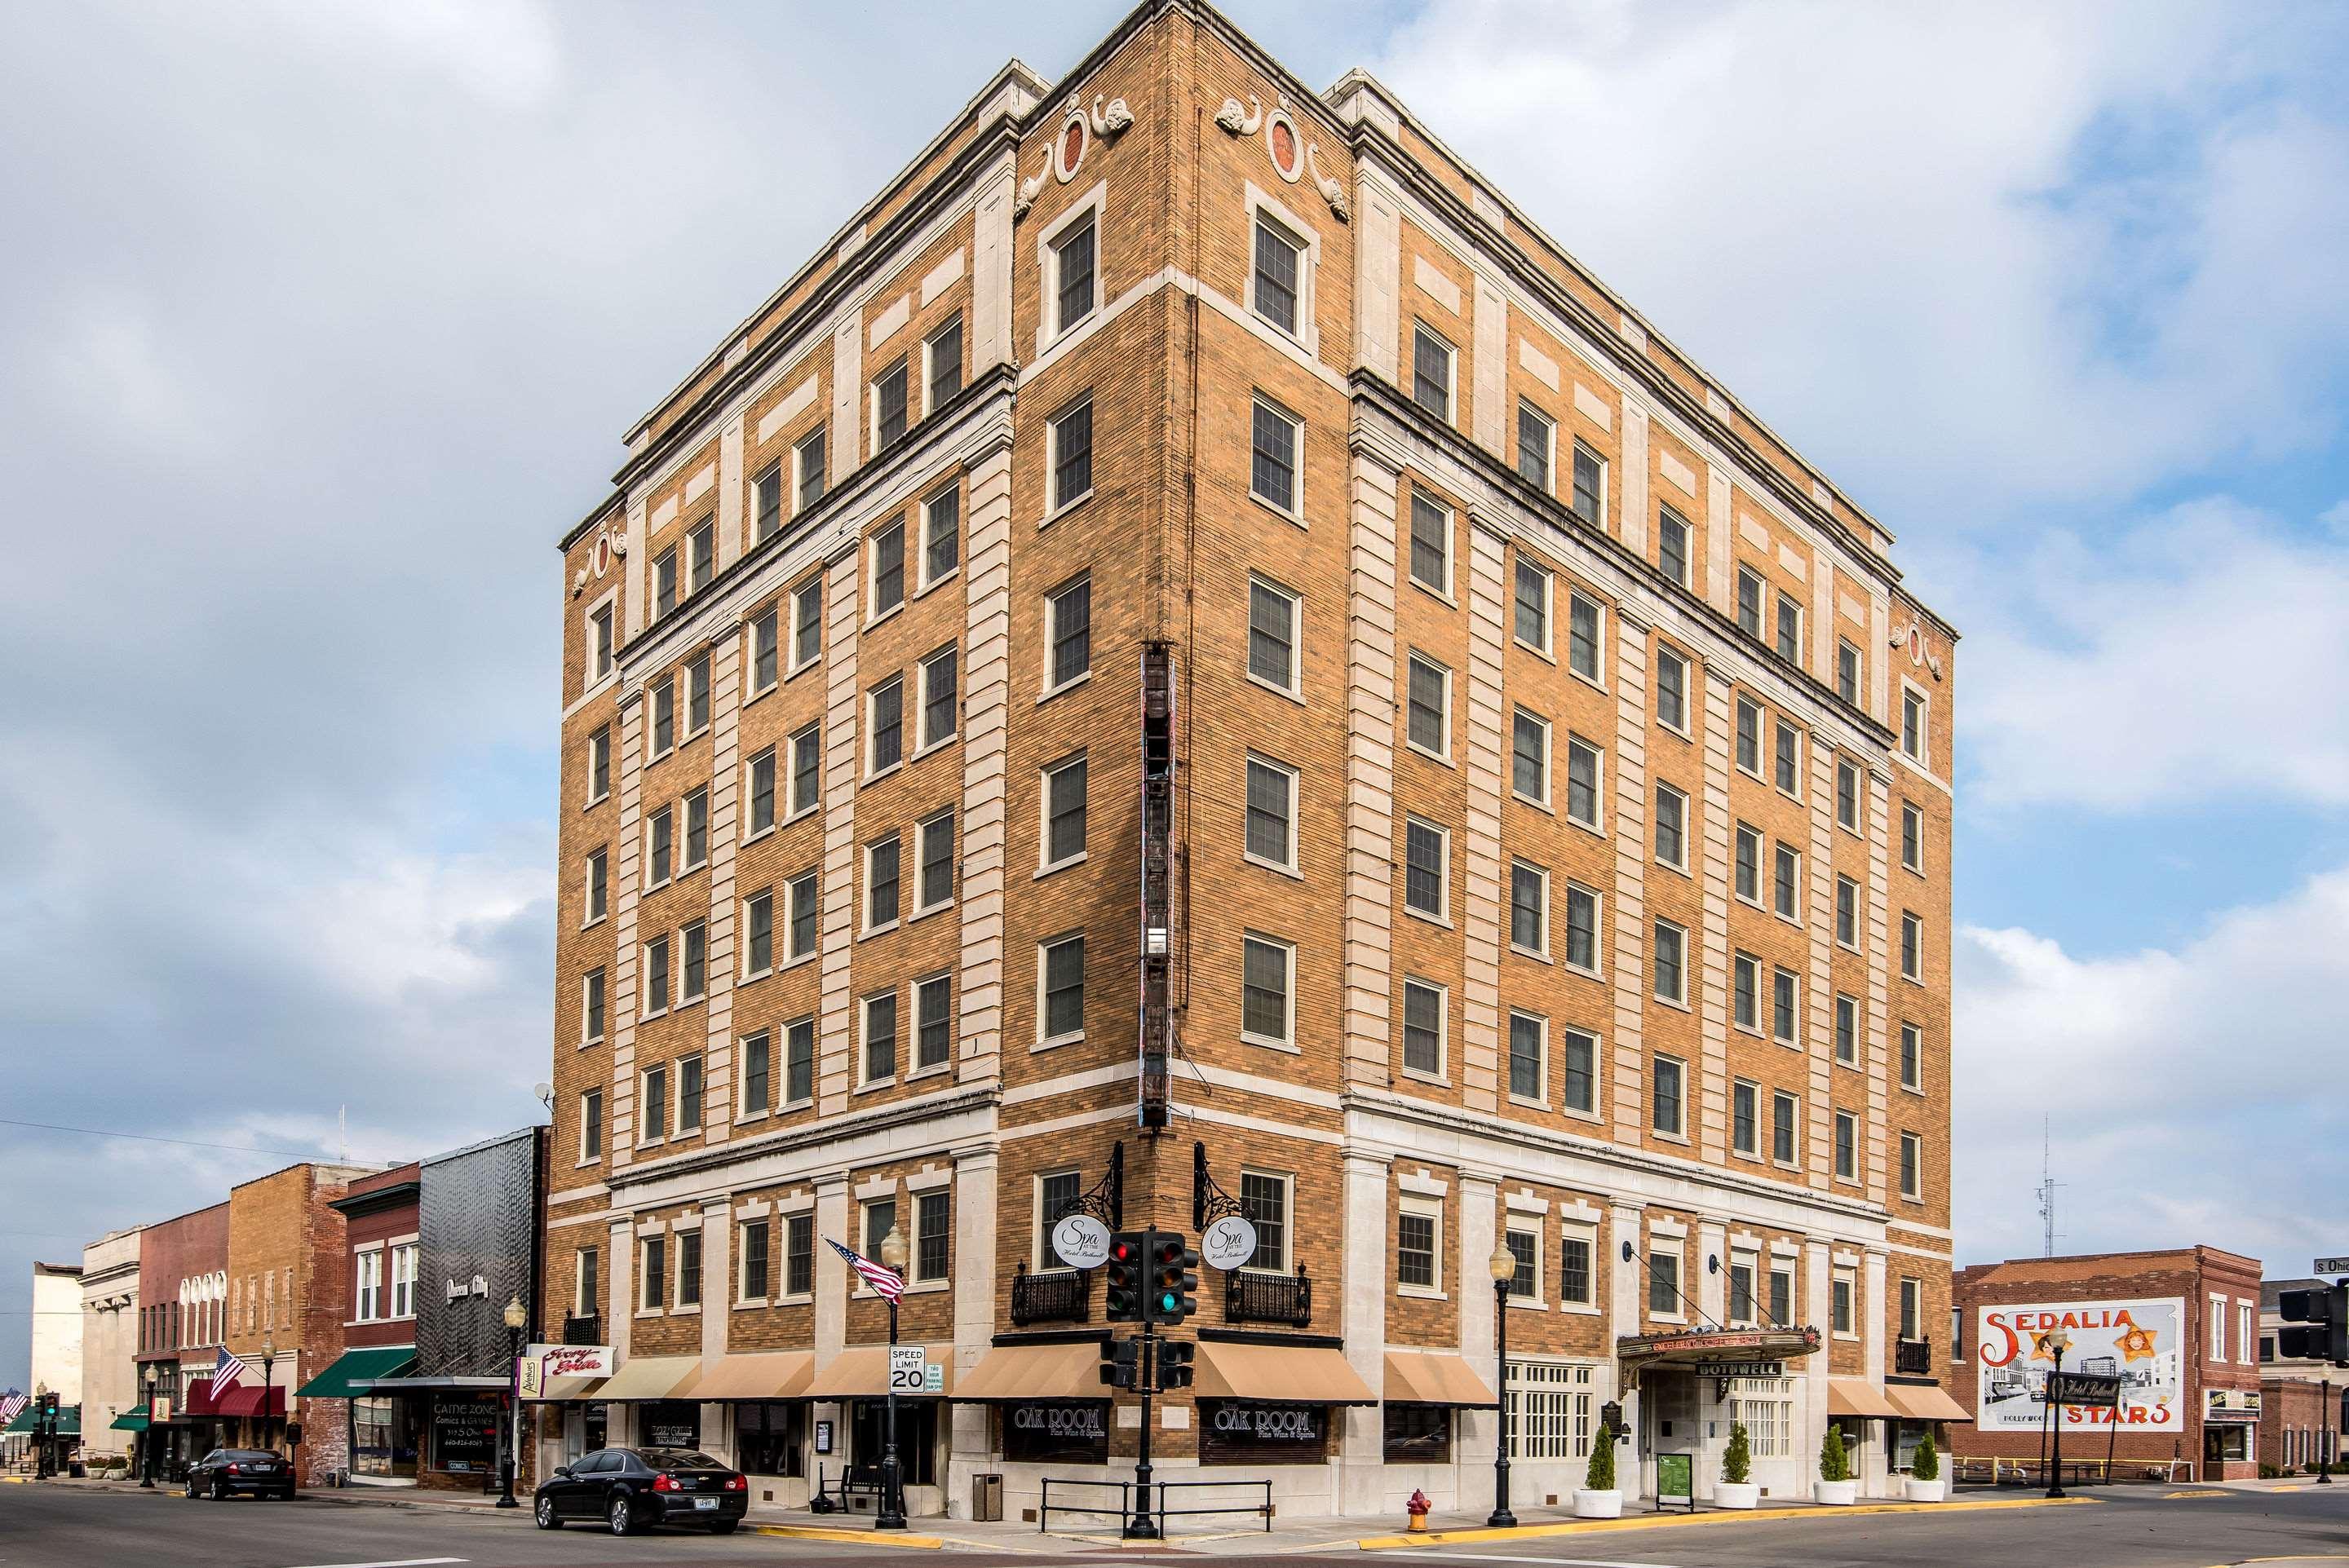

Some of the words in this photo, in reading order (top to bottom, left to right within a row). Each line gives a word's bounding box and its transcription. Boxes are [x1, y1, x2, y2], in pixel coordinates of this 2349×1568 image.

[1062, 1220, 1099, 1251] Spa
[1210, 1222, 1244, 1252] Spa
[2317, 1263, 2324, 1272] S
[1980, 1310, 2134, 1367] SEDALIA
[892, 1370, 923, 1388] 20
[1700, 1363, 1776, 1376] BOTHWELL
[2064, 1380, 2088, 1395] Hotel
[434, 1404, 467, 1415] GAME
[469, 1404, 497, 1415] ZONE
[1015, 1409, 1045, 1429] OAK
[1048, 1409, 1099, 1429] ROOM
[2068, 1403, 2170, 1424] STARS
[436, 1416, 459, 1424] Comics
[1215, 1411, 1251, 1430] OAK
[1255, 1411, 1309, 1431] ROOM
